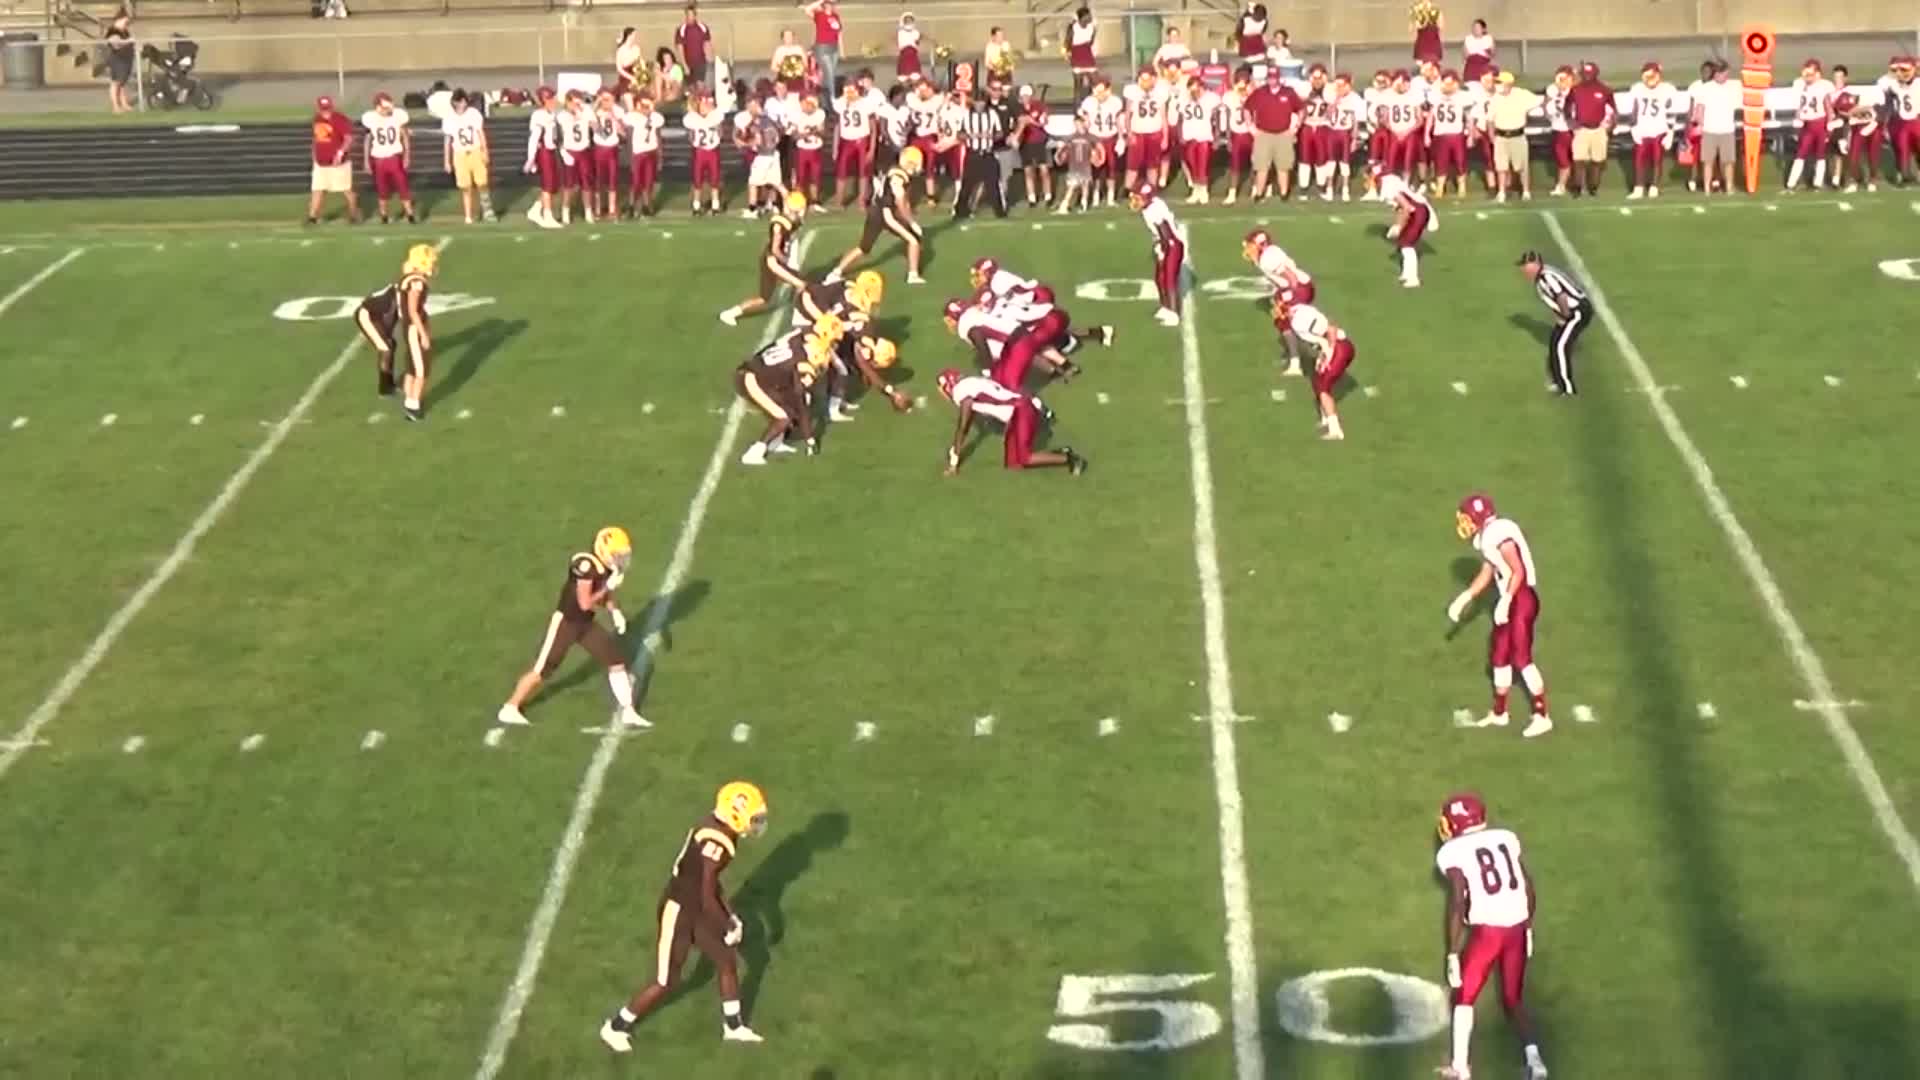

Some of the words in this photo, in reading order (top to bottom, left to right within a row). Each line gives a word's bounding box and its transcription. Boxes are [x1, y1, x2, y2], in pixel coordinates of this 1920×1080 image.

[1184, 103, 1203, 120] 50
[1391, 104, 1411, 123] 85
[1437, 103, 1456, 123] 65
[1642, 97, 1660, 117] 75
[842, 109, 861, 128] 59
[913, 110, 934, 129] 57
[1094, 113, 1114, 131] 44
[376, 127, 397, 145] 60
[1475, 843, 1519, 896] 81
[1047, 967, 1448, 1052] 50
